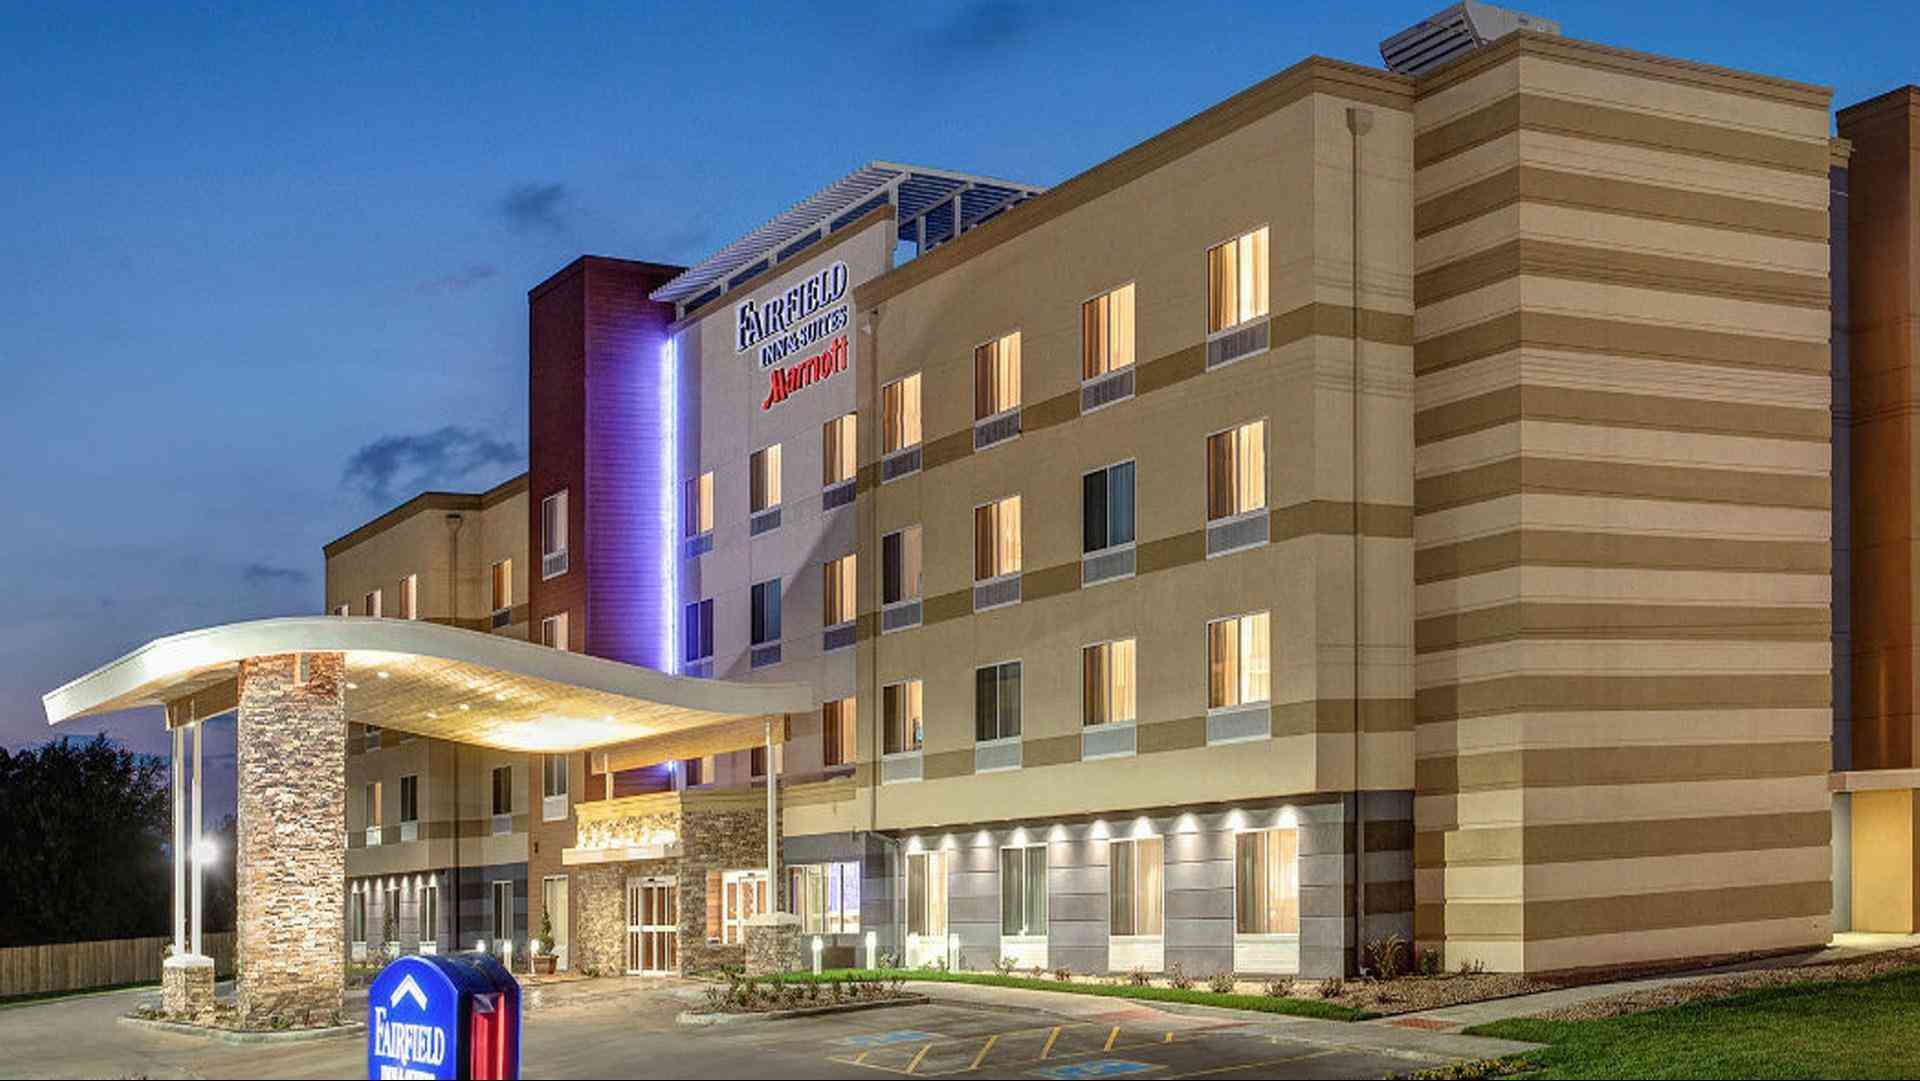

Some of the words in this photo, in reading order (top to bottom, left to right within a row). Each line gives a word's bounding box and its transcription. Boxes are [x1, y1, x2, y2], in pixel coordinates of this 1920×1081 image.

[736, 261, 849, 353] FAIRFIELD
[761, 335, 849, 412] Marriott
[374, 1007, 445, 1066] FAIRFIELD
